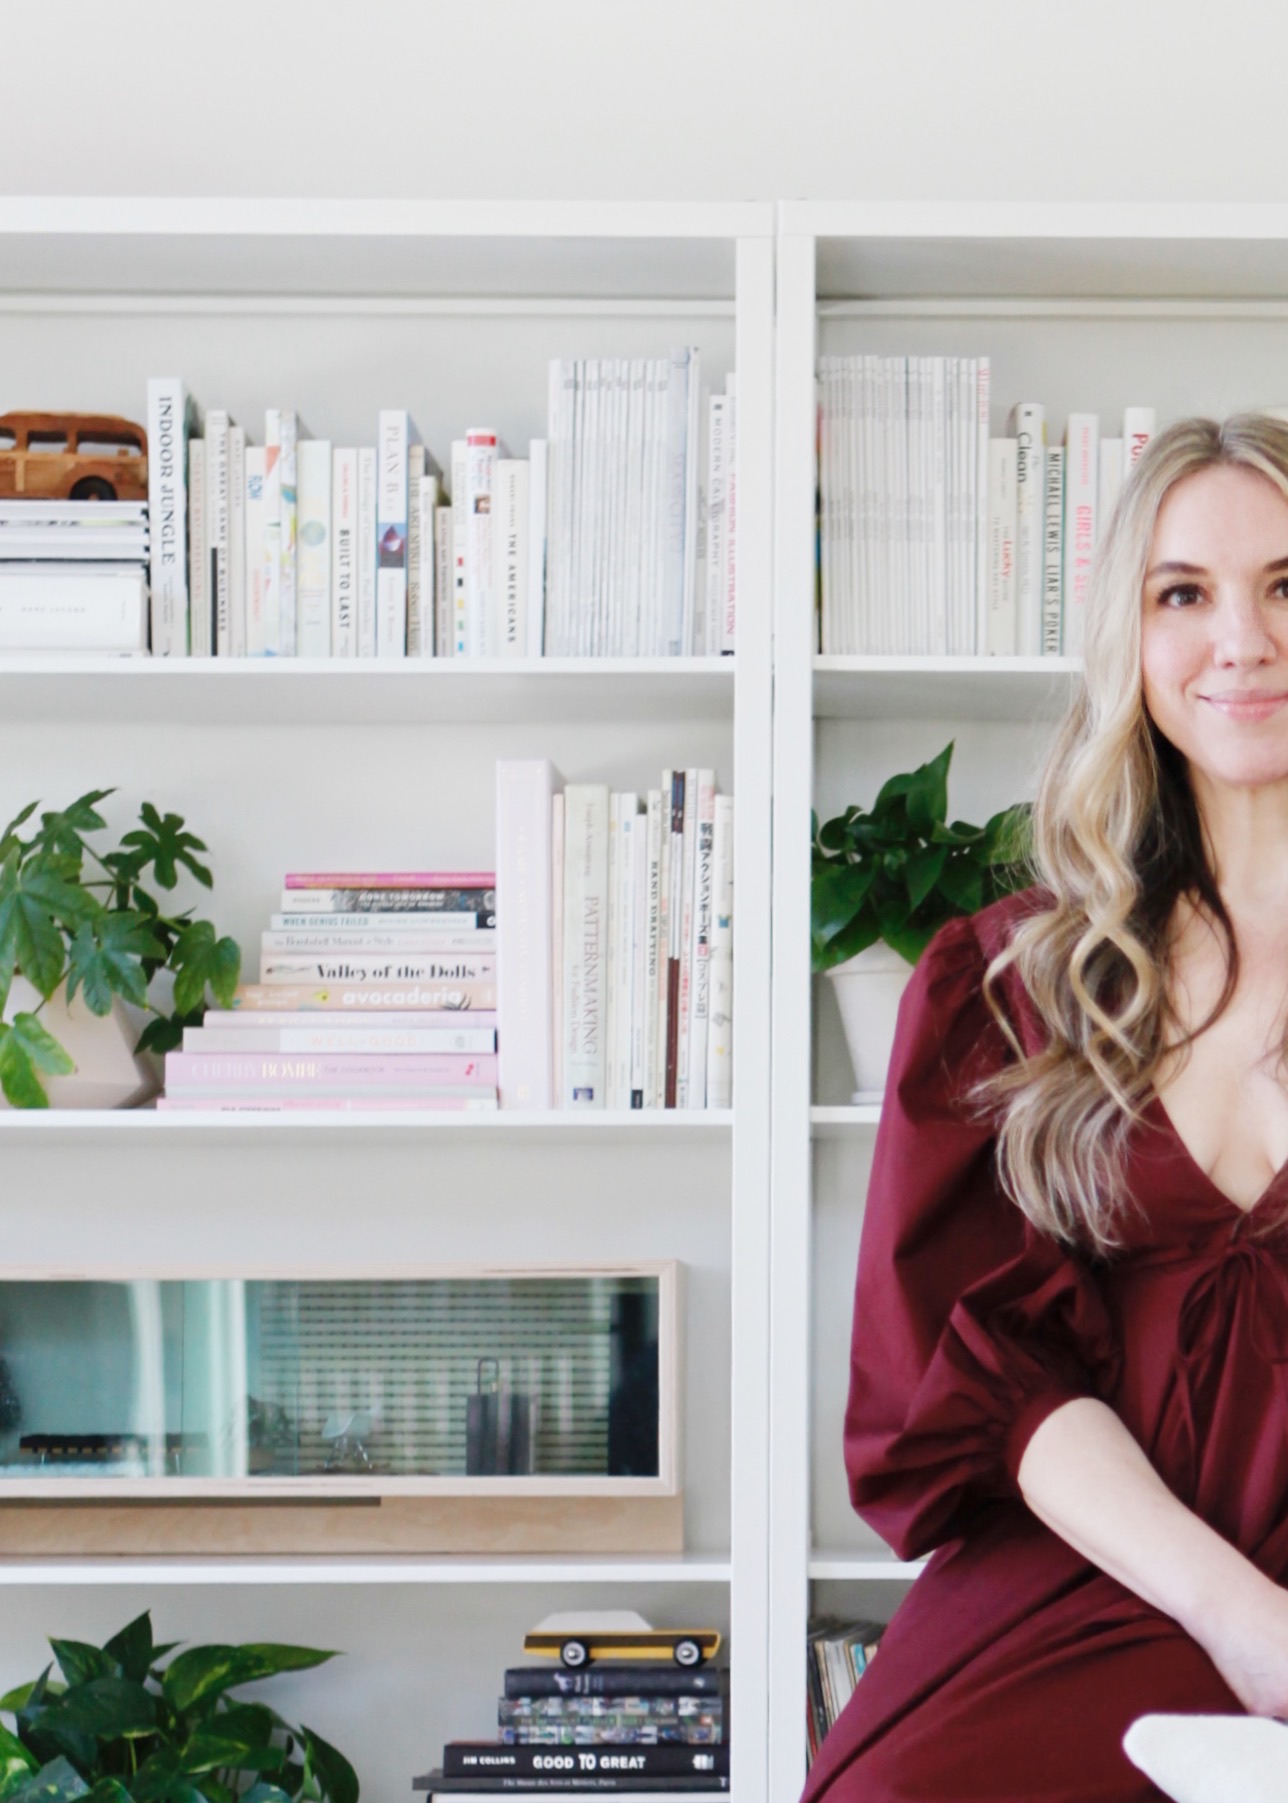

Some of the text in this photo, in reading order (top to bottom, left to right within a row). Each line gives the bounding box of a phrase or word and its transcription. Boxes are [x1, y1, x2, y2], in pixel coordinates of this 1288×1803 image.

[386, 425, 400, 476] PLAN
[711, 417, 722, 472] MODERN
[1017, 432, 1032, 484] Clean
[159, 396, 175, 565] INDOOR JUNGLE
[218, 461, 227, 501] GREAT
[386, 482, 400, 494] B
[218, 507, 227, 542] GAME
[1047, 453, 1061, 554] MICHAEL LEWIS
[1075, 506, 1093, 551] GIRLS
[218, 548, 227, 562] OF
[1000, 540, 1013, 578] Lucky
[1075, 556, 1092, 569] &
[218, 569, 227, 632] BUSINESS
[339, 529, 350, 629] BUILT TO LAST
[507, 533, 517, 644] THE AMERICANS
[1045, 564, 1060, 654] LIAR'S POKER
[283, 917, 369, 927] WHEN GENIUS FAILED
[648, 861, 660, 977] HAND DRAFTING
[317, 964, 476, 981] Valley of the Dolls
[583, 895, 600, 1056] PATTERNMAKING
[342, 988, 462, 1005] avocaderia
[463, 1755, 517, 1766] JIM COLLINS
[532, 1752, 646, 1771] GOOD TO GREAT
